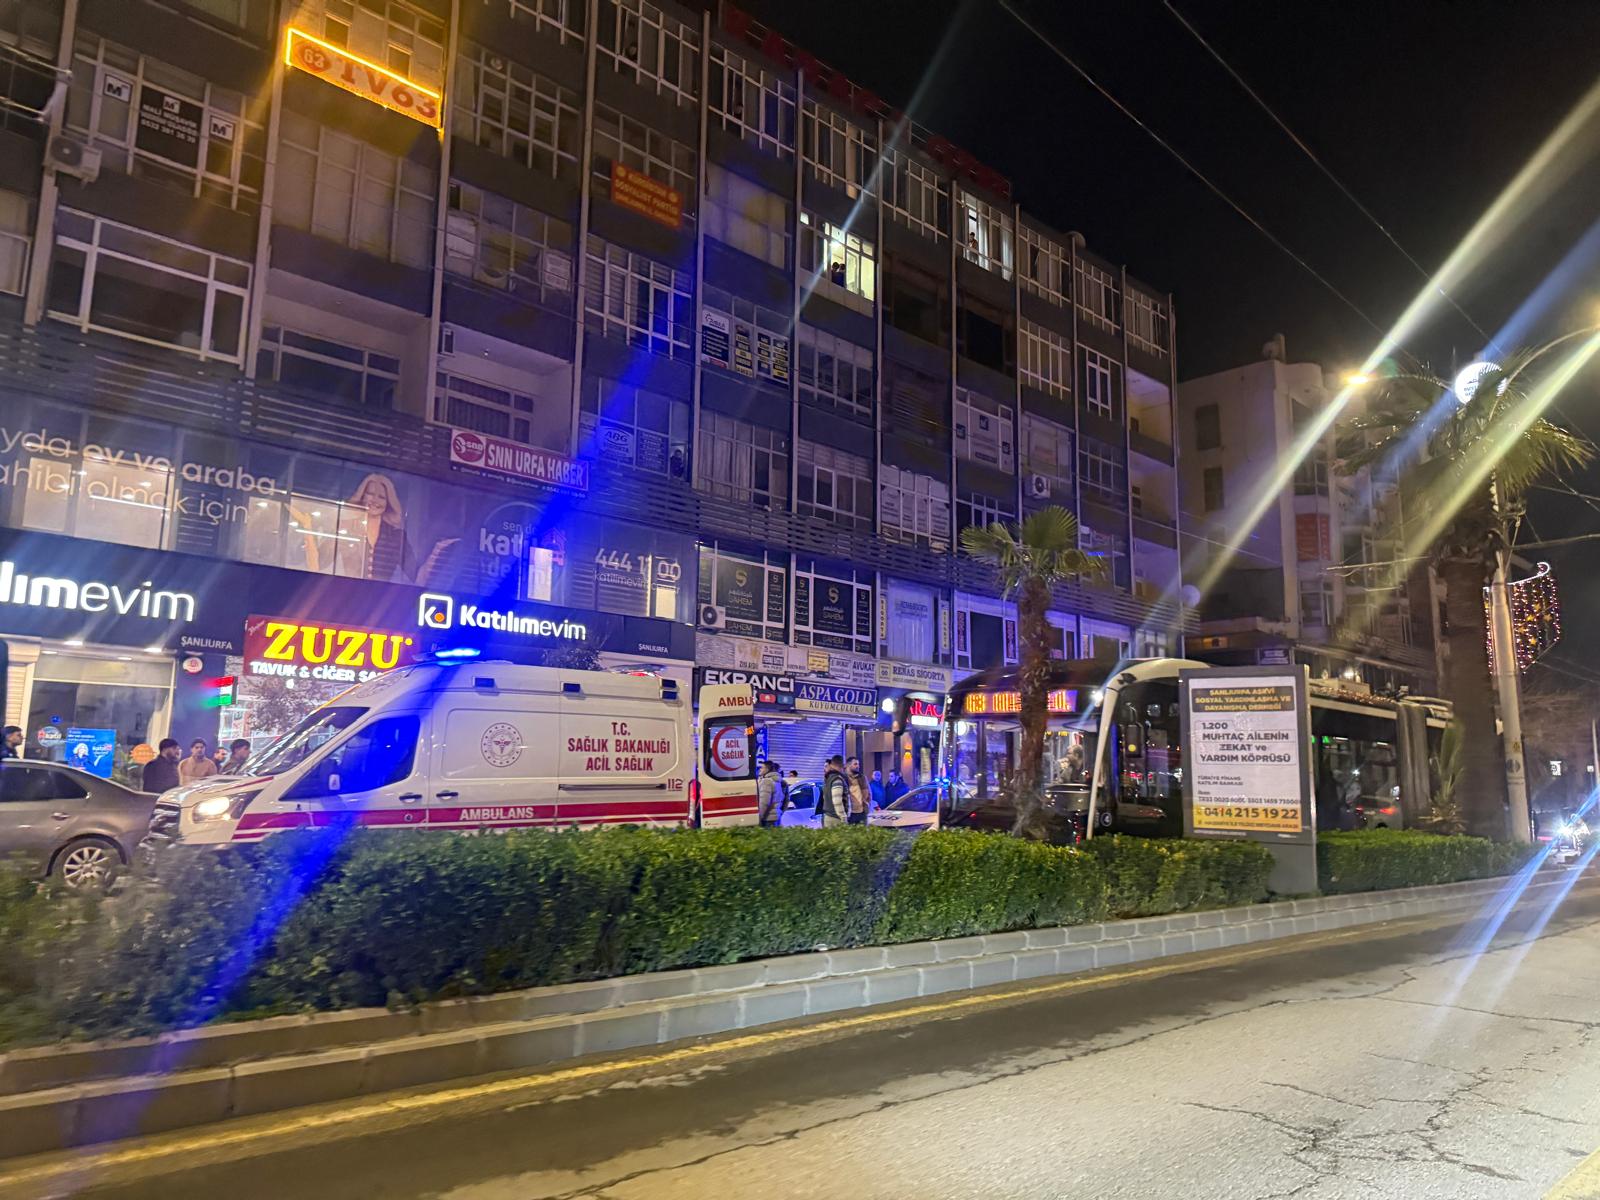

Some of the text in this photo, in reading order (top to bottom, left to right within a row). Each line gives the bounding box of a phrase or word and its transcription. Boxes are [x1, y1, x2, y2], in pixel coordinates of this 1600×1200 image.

[332, 56, 437, 118] TV63
[82, 444, 125, 466] ev
[181, 462, 276, 496] araba
[487, 444, 513, 470] SNN
[515, 449, 545, 478] URFA
[547, 457, 584, 486] HABER
[87, 475, 189, 514] olmak
[200, 493, 249, 525] için
[595, 547, 633, 572] 444
[460, 604, 587, 641] Katılımevim
[180, 635, 233, 650] ŞANLIURFA
[263, 622, 404, 669] ZUZU
[249, 661, 298, 677] TAVUK
[299, 666, 311, 678] &
[312, 664, 355, 681] CİĞER
[798, 685, 873, 705] ASPA GOLD
[611, 722, 631, 736] T.C.
[1202, 722, 1228, 730] 1.200
[567, 735, 671, 754] SAĞLIK BAKANLIĞI
[725, 738, 740, 749] ACİL
[1202, 732, 1289, 742] MUHTAÇ AİLENİN
[585, 754, 654, 771] ACİL SAĞLIK
[721, 748, 745, 760] SAĞLIK
[1200, 753, 1291, 763] YARDIM KÖPRÜSÜ
[667, 779, 683, 790] 112
[459, 807, 534, 821] AMBULANS
[1204, 807, 1299, 820] 0414 215 19 22
